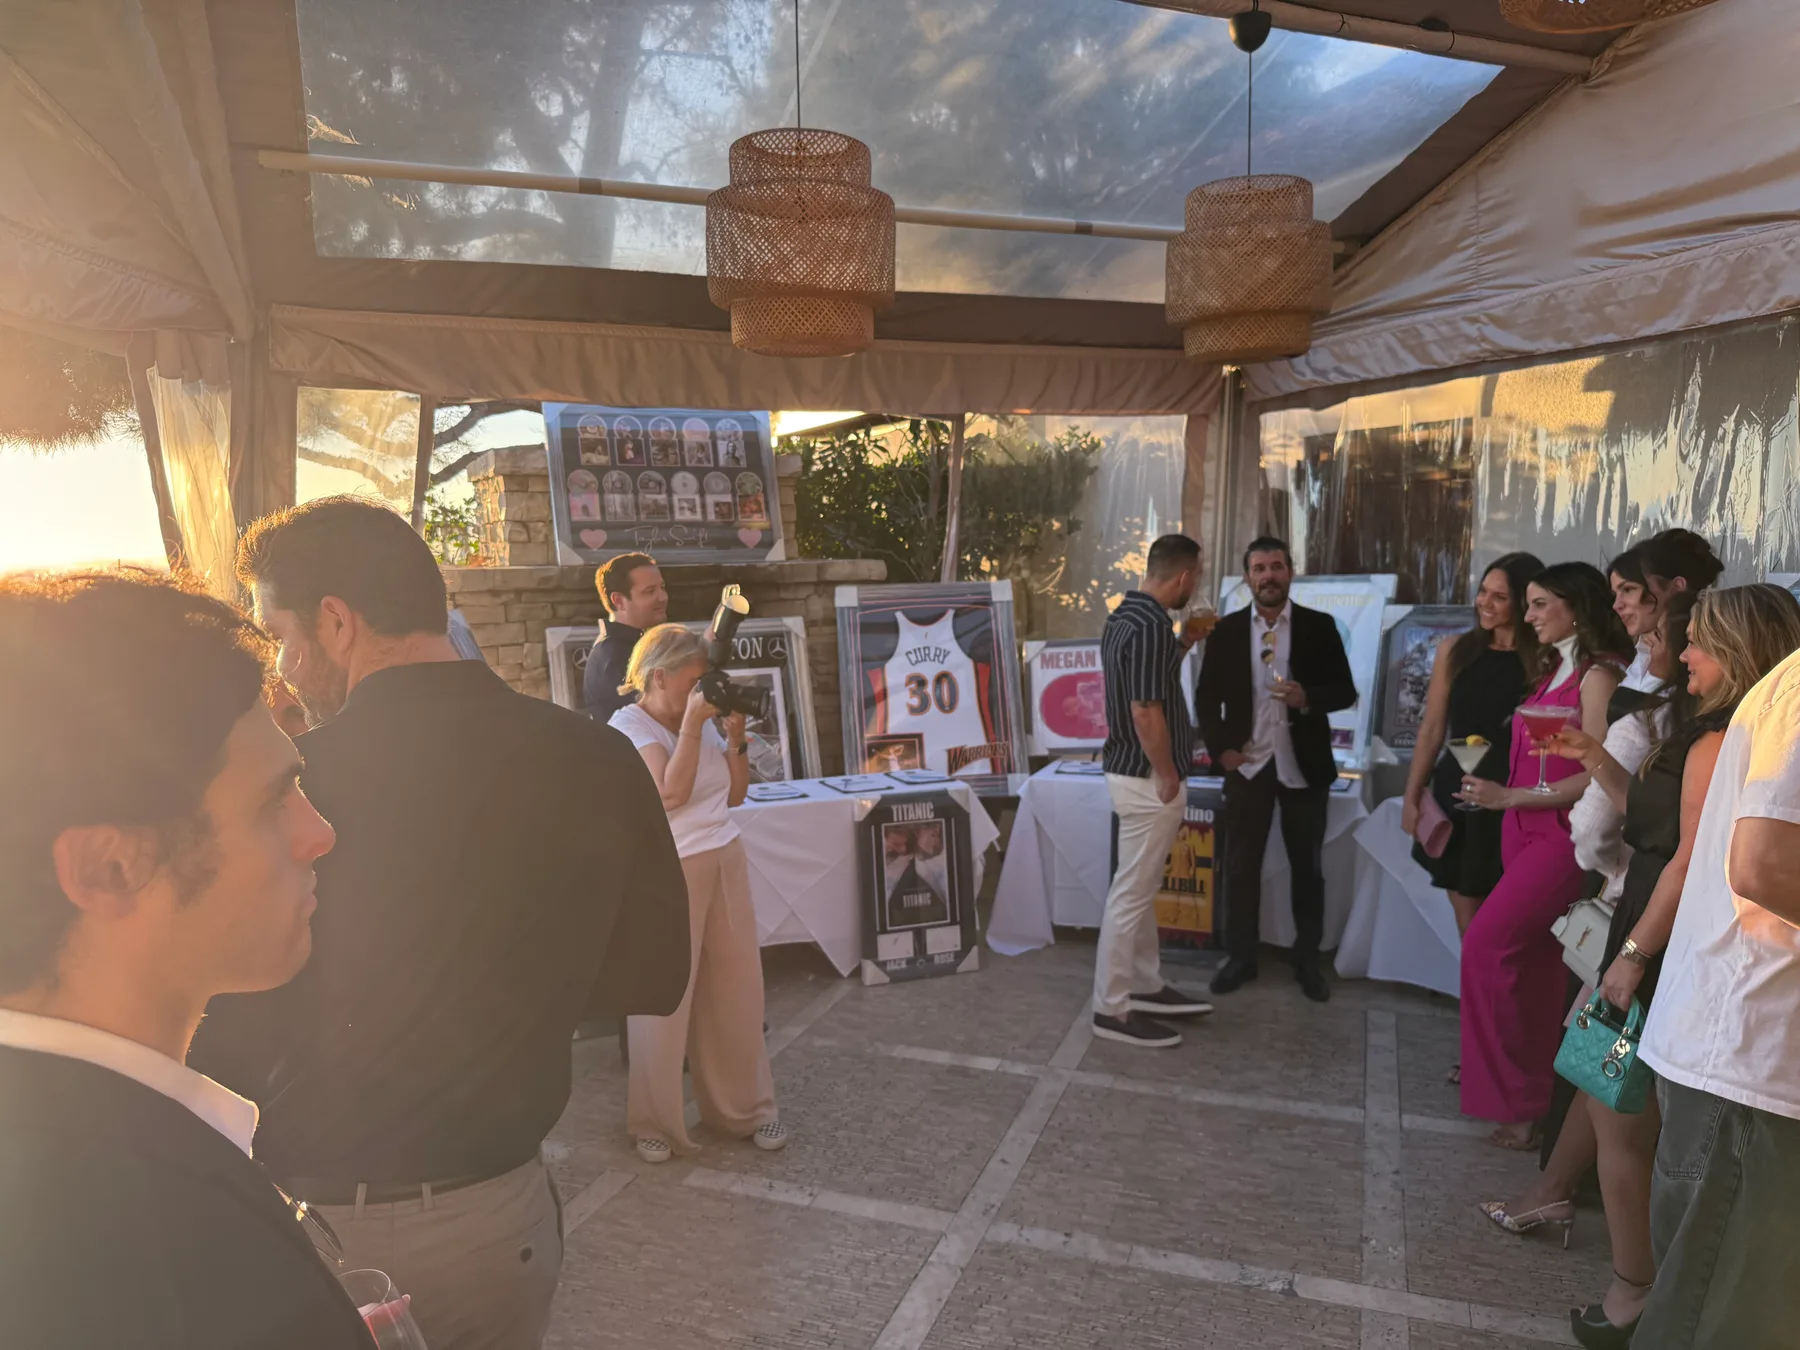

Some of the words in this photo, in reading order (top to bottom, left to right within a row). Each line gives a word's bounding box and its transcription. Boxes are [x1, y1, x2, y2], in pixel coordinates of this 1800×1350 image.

[624, 525, 667, 554] Taylor
[668, 524, 708, 549] Swift
[905, 646, 951, 666] CURRY
[1040, 649, 1096, 669] MEGAN
[904, 670, 960, 717] 30
[946, 742, 1009, 775] WARRIORS
[892, 802, 934, 822] TITANIC
[903, 892, 931, 908] TITANIC
